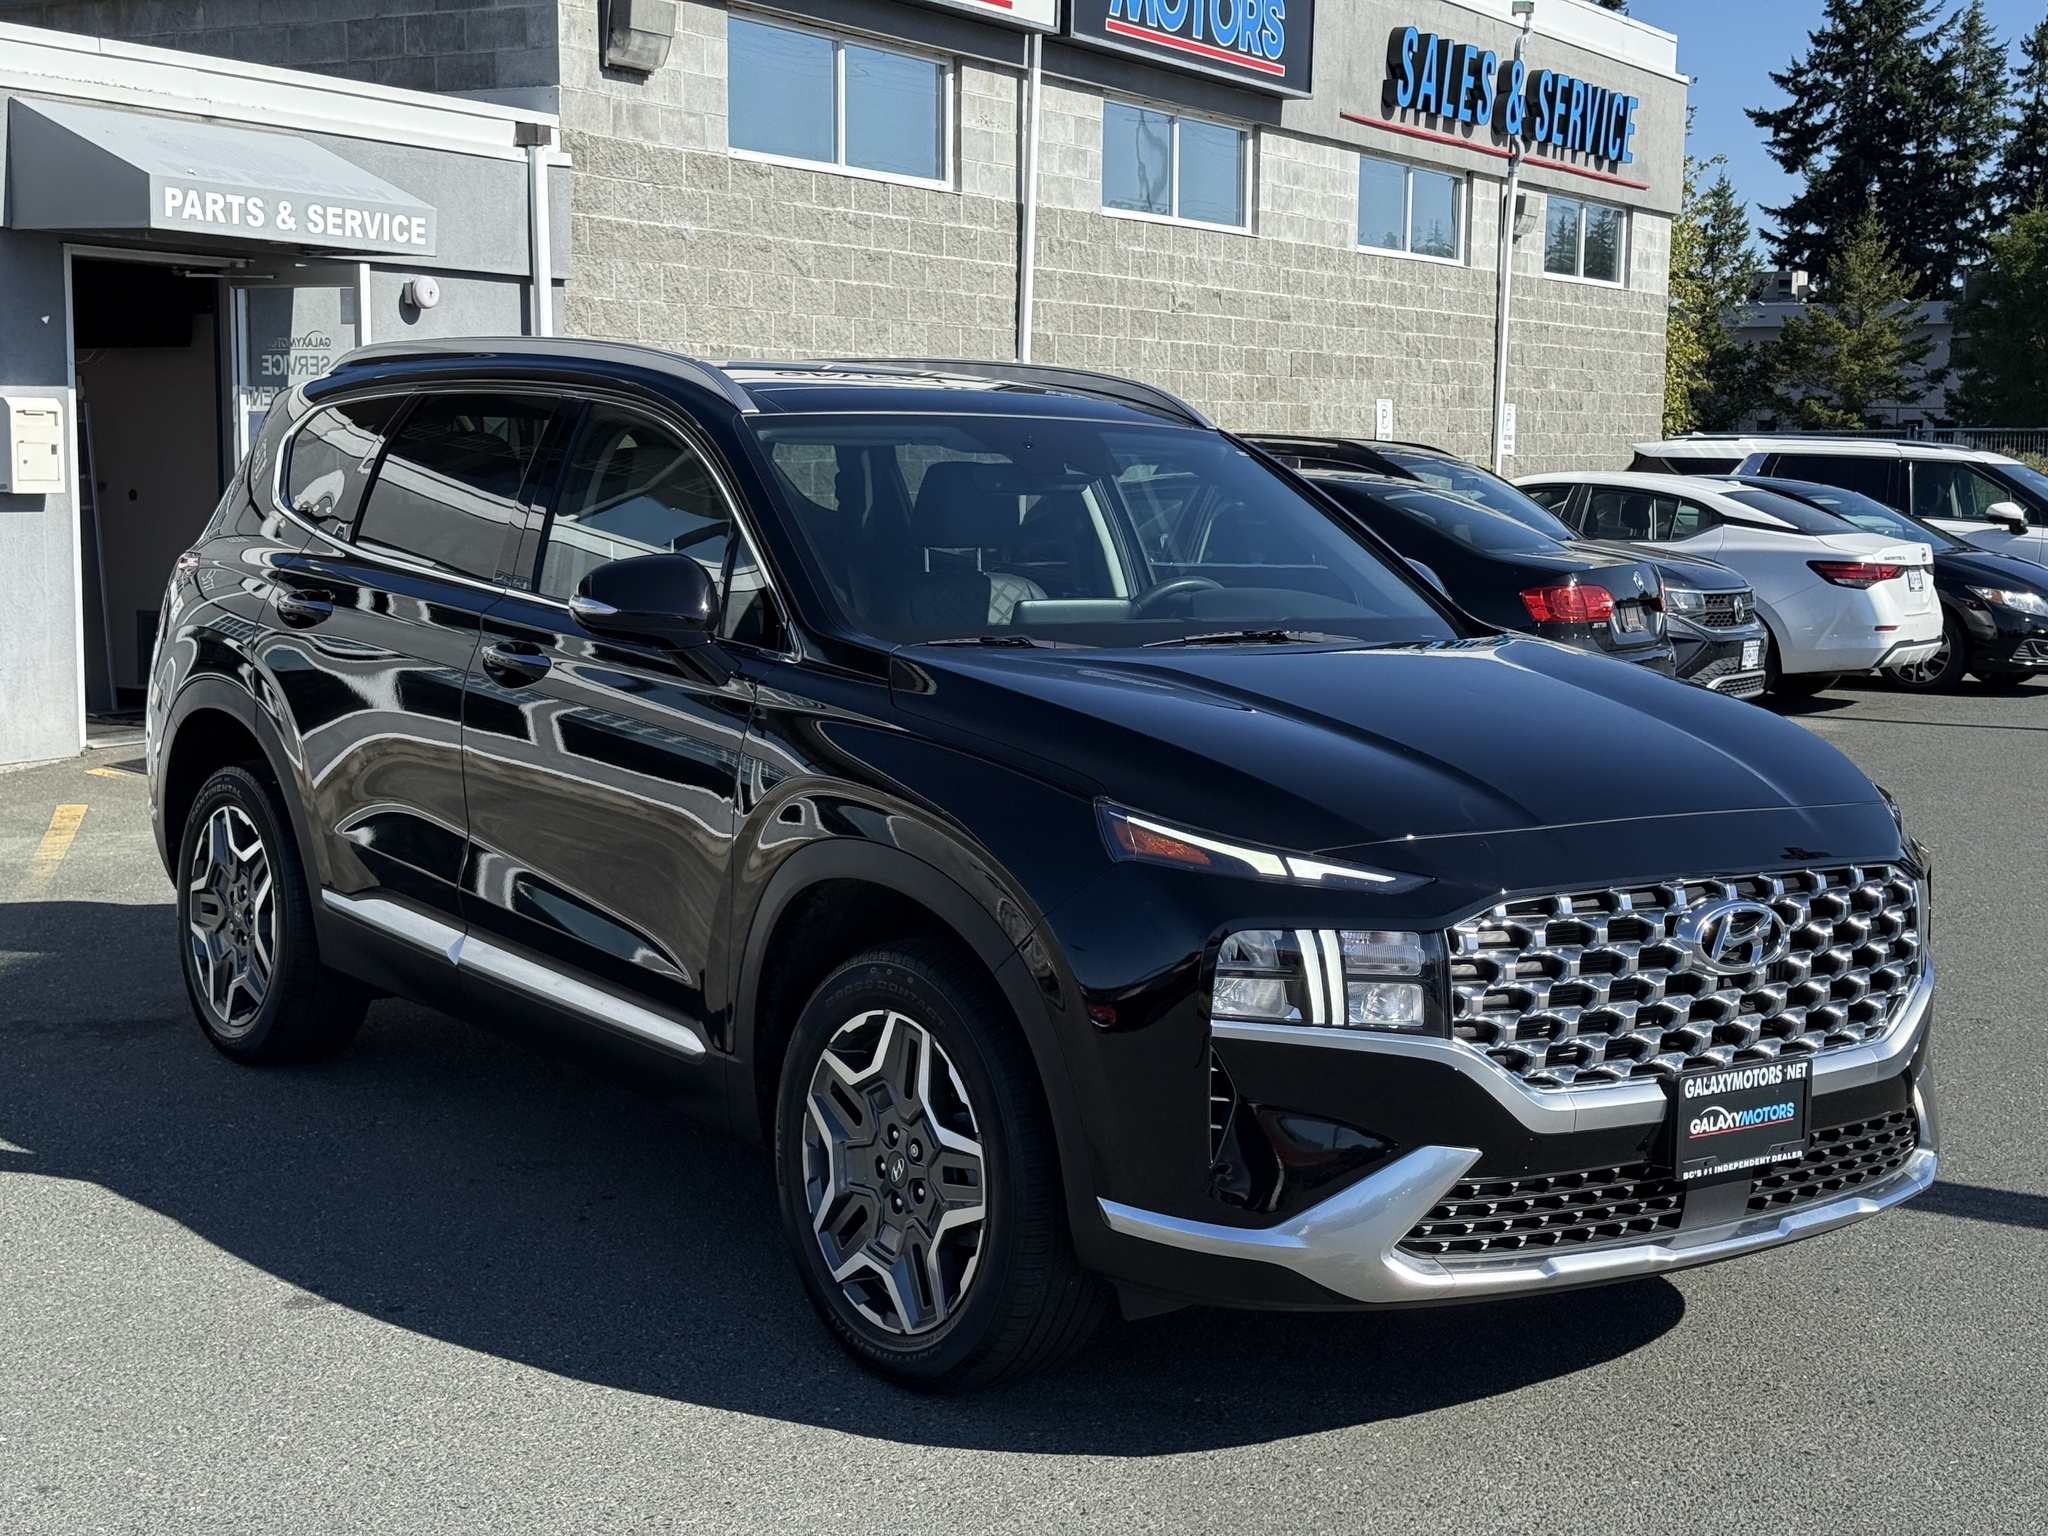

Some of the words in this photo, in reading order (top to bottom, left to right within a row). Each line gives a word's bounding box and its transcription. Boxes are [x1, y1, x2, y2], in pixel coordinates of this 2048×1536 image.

[1108, 0, 1286, 60] TORS
[1396, 26, 1497, 126] SALES
[1505, 59, 1525, 136] &
[1534, 69, 1639, 164] SERVICE
[163, 186, 266, 228] PARTS
[275, 200, 297, 232] &
[307, 204, 427, 246] SERVICE
[1689, 1101, 1796, 1136] GALAXYMOTORS
[1682, 1169, 1702, 1180] BC'S
[1714, 1155, 1771, 1174] INDEPENDENT
[1771, 1150, 1803, 1163] DEALER
